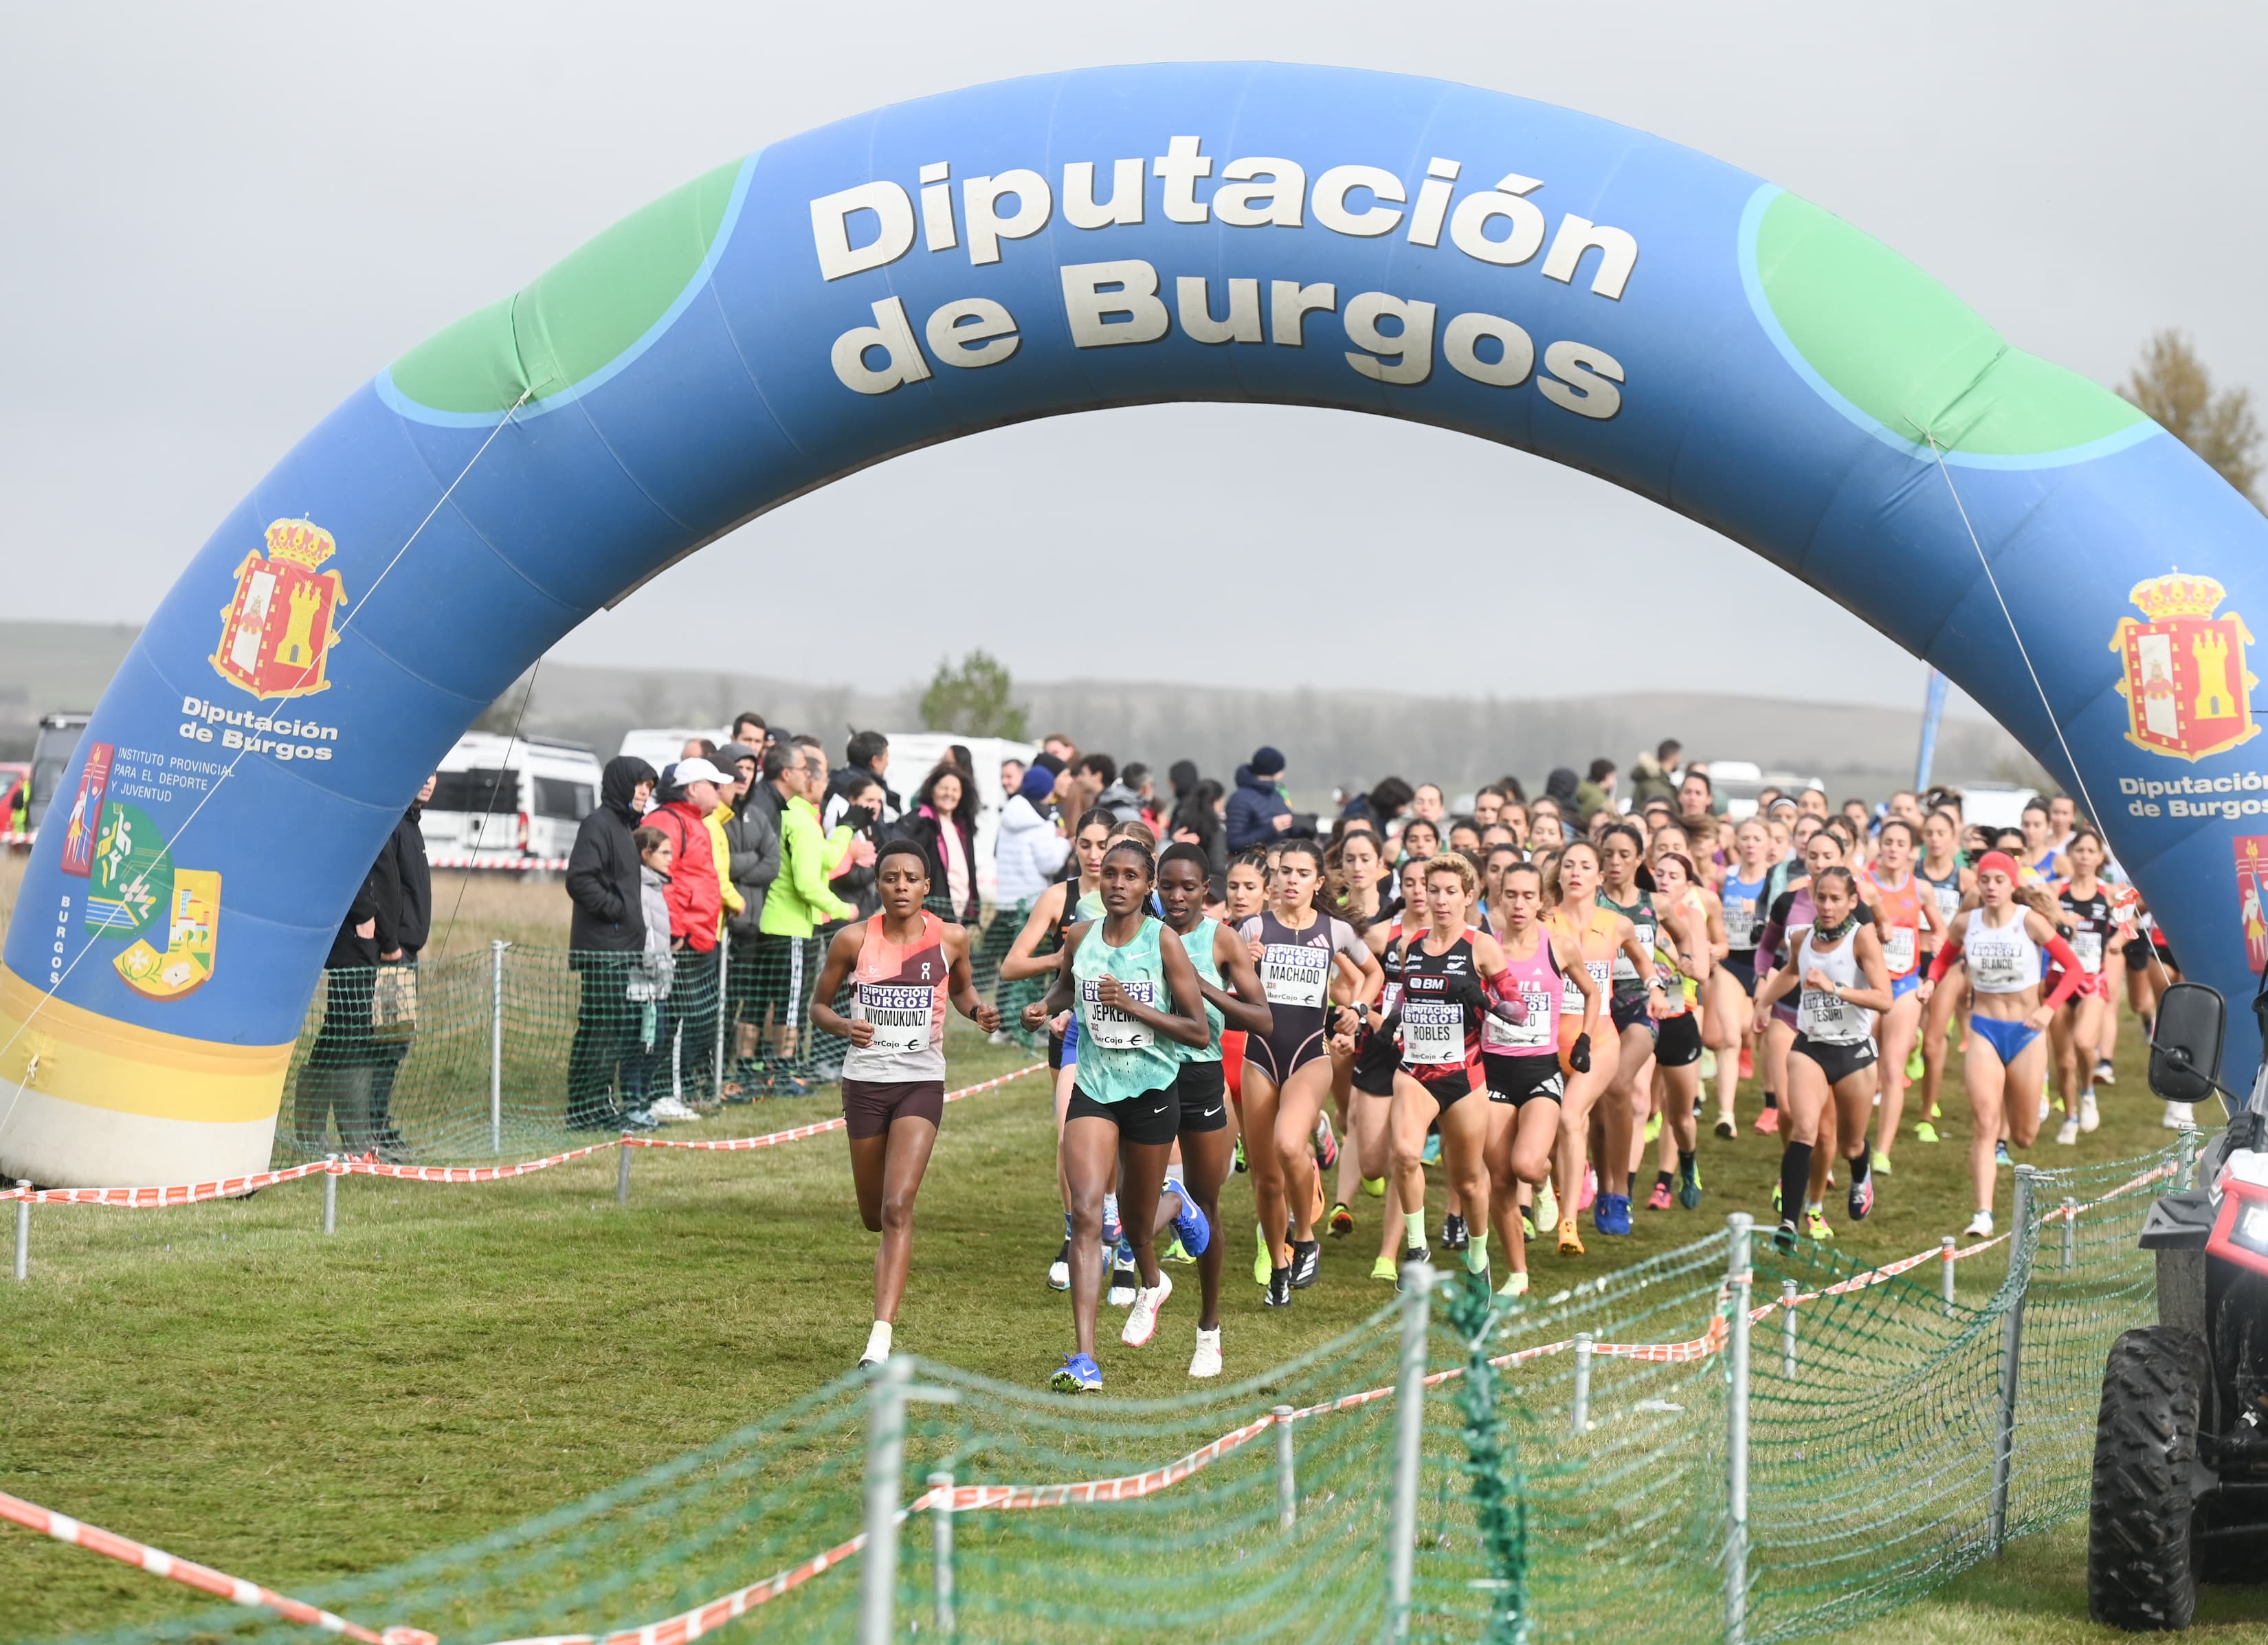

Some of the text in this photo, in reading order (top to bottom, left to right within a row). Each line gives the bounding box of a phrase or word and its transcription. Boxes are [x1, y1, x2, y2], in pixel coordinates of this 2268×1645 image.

[810, 135, 1639, 302] Diputación
[830, 258, 1626, 421] de Burgos
[181, 696, 339, 740] Diputación
[179, 721, 333, 761] de Burgos
[118, 747, 235, 777] INSTITUTO PROVINCIAL
[114, 764, 208, 791] PARA EL DEPORTE
[111, 781, 172, 802] Y JUVENTUD
[2128, 799, 2161, 817] de
[50, 895, 71, 984] BURGOS
[1266, 953, 1324, 968] BURGOS
[1981, 958, 2013, 971] BLANCO
[1269, 965, 1320, 984] MACHADO
[1423, 978, 1444, 989] BM
[862, 985, 929, 997] DIPUTACIÓN
[1085, 990, 1150, 1002] BUOS
[862, 995, 929, 1008] BURGOS
[865, 1006, 926, 1026] NIYOMUKUNZI
[1092, 1004, 1138, 1022] JEPKEM
[1405, 1013, 1458, 1024] BURGOS
[1813, 1008, 1843, 1023] TESURI
[1091, 1023, 1099, 1031] 302
[1414, 1026, 1449, 1041] ROBLES
